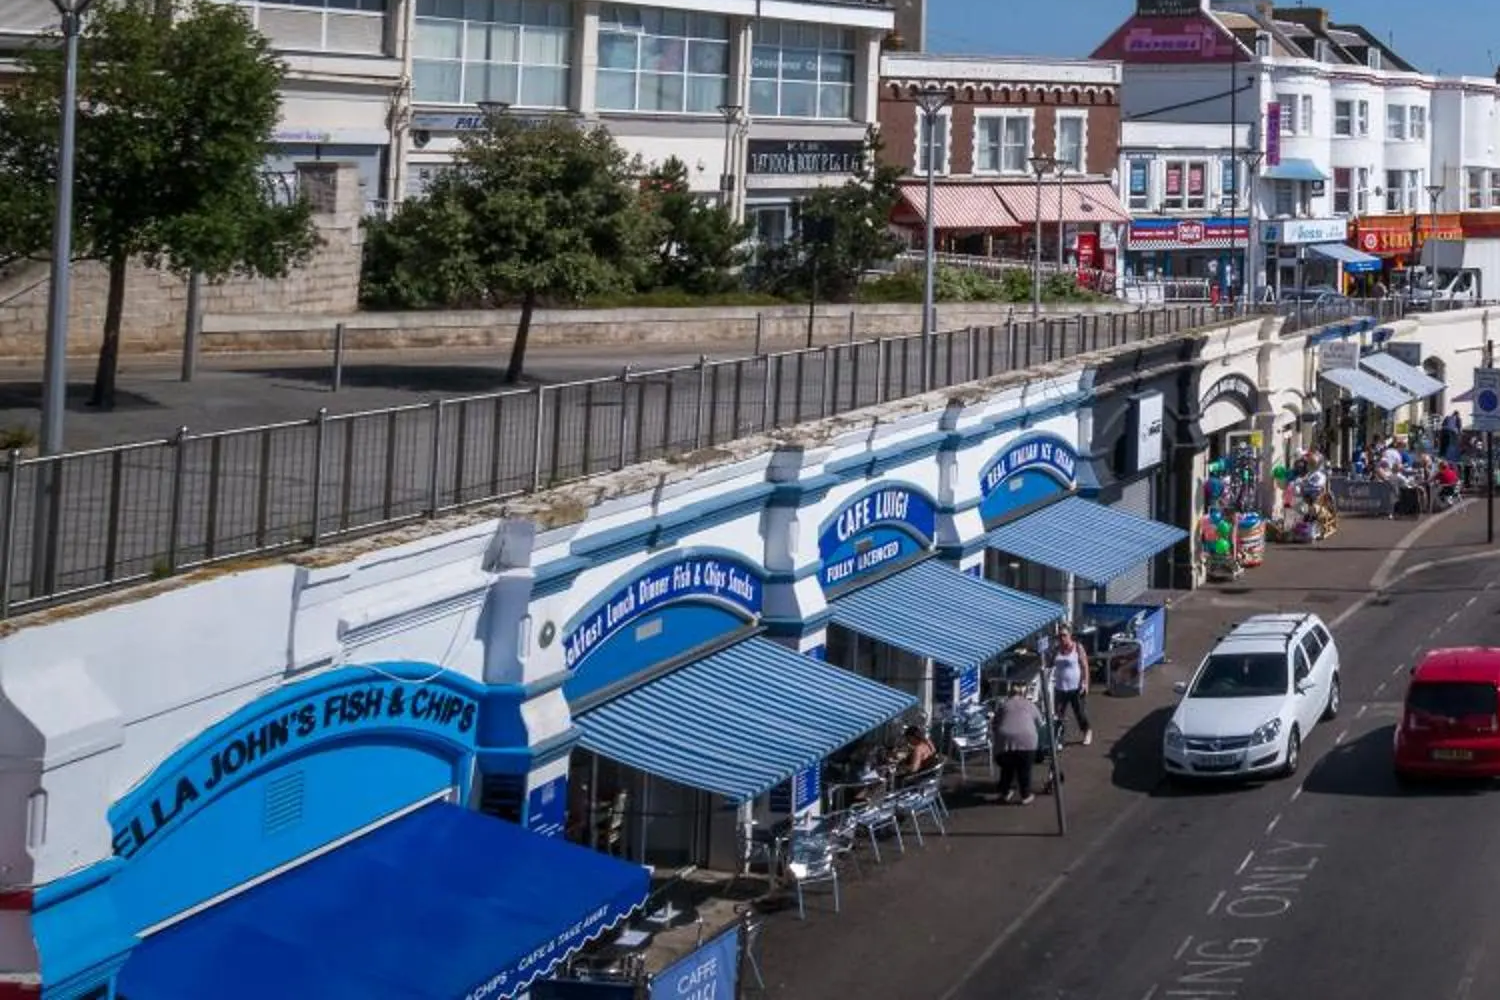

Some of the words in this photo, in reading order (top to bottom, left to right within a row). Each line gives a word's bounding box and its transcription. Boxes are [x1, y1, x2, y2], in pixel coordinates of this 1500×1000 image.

[987, 460, 1006, 489] REAL
[837, 497, 871, 541] CAFE
[876, 491, 910, 520] LUIGI
[827, 557, 855, 583] FULLY
[566, 615, 602, 666] akfast
[607, 587, 635, 627] Lunch
[639, 573, 670, 605] Dinner
[673, 561, 691, 590] Fish
[694, 561, 700, 585] &
[704, 560, 726, 594] Chips
[728, 567, 753, 601] Snacks
[204, 703, 316, 790] JOHN'S
[323, 687, 385, 728] FISH
[387, 685, 405, 718] &
[411, 687, 476, 733] CHIPS
[1164, 937, 1269, 1000] ING
[1225, 839, 1329, 918] ONLY
[474, 970, 508, 1000] CHIPS
[518, 945, 546, 972] CAFE
